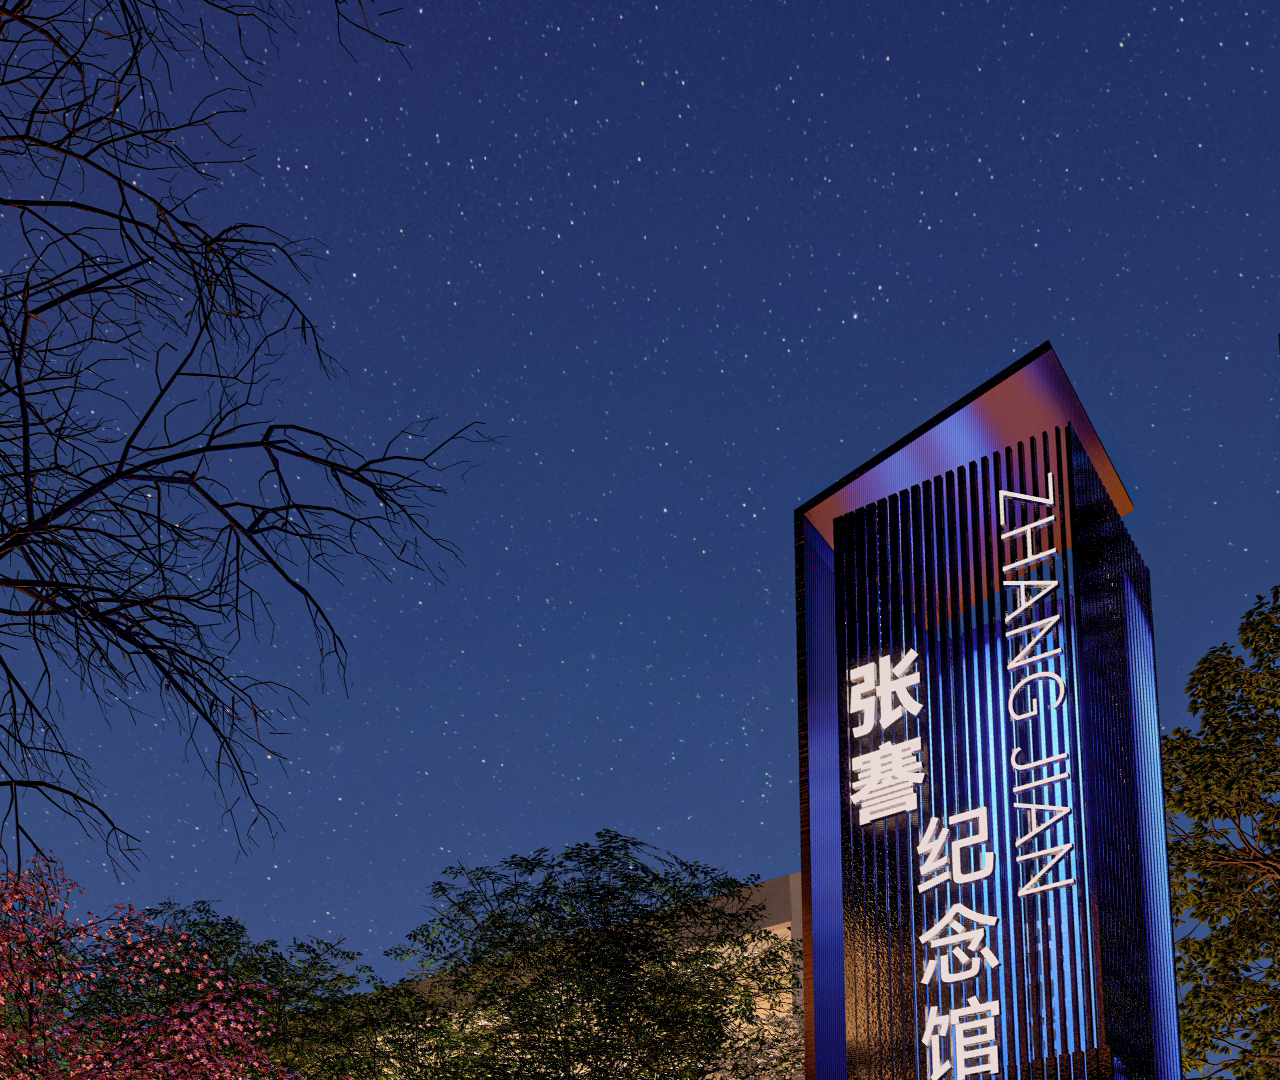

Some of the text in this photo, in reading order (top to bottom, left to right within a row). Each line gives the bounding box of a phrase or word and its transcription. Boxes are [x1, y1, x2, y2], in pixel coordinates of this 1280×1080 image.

[849, 648, 925, 826] 张謇
[998, 471, 1076, 898] ZHANG JIAN
